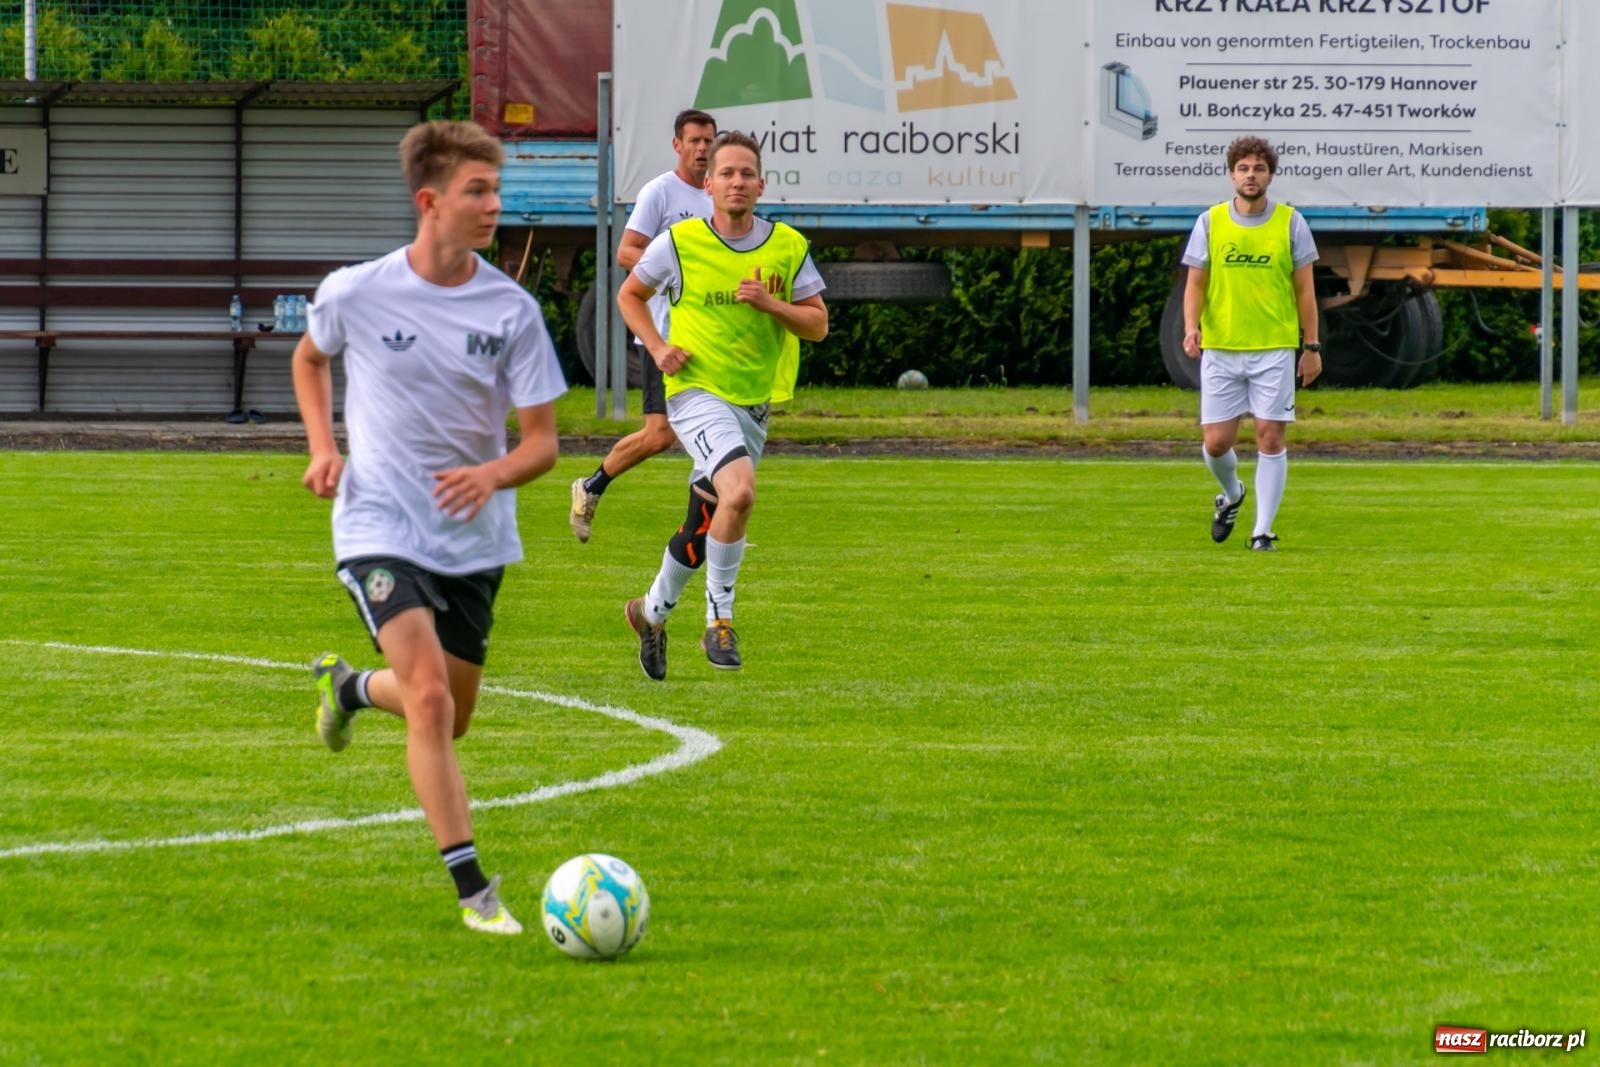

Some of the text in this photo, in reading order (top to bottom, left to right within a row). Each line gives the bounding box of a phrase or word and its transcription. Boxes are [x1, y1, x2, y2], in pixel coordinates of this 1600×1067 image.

[1319, 0, 1490, 14] KRZYSZTOF
[1115, 32, 1531, 53] Einbau von genormten Fertigteilen, Trockenbau
[1179, 75, 1478, 91] Plauener str 25. 30-179 Hannover
[1180, 103, 1476, 121] Ul. Bończyka 25. 47-451 Tworków
[843, 121, 1020, 154] raciborski
[1165, 141, 1226, 156] Fenster
[1316, 142, 1404, 158] Haustüren,
[1409, 142, 1483, 156] Markisen
[827, 168, 903, 186] oaza
[927, 165, 1021, 187] kultur
[1276, 165, 1343, 180] ontagen
[1347, 163, 1383, 177] aller
[1387, 163, 1416, 179] Art,
[1421, 163, 1534, 177] Kundendienst
[694, 429, 714, 461] 17
